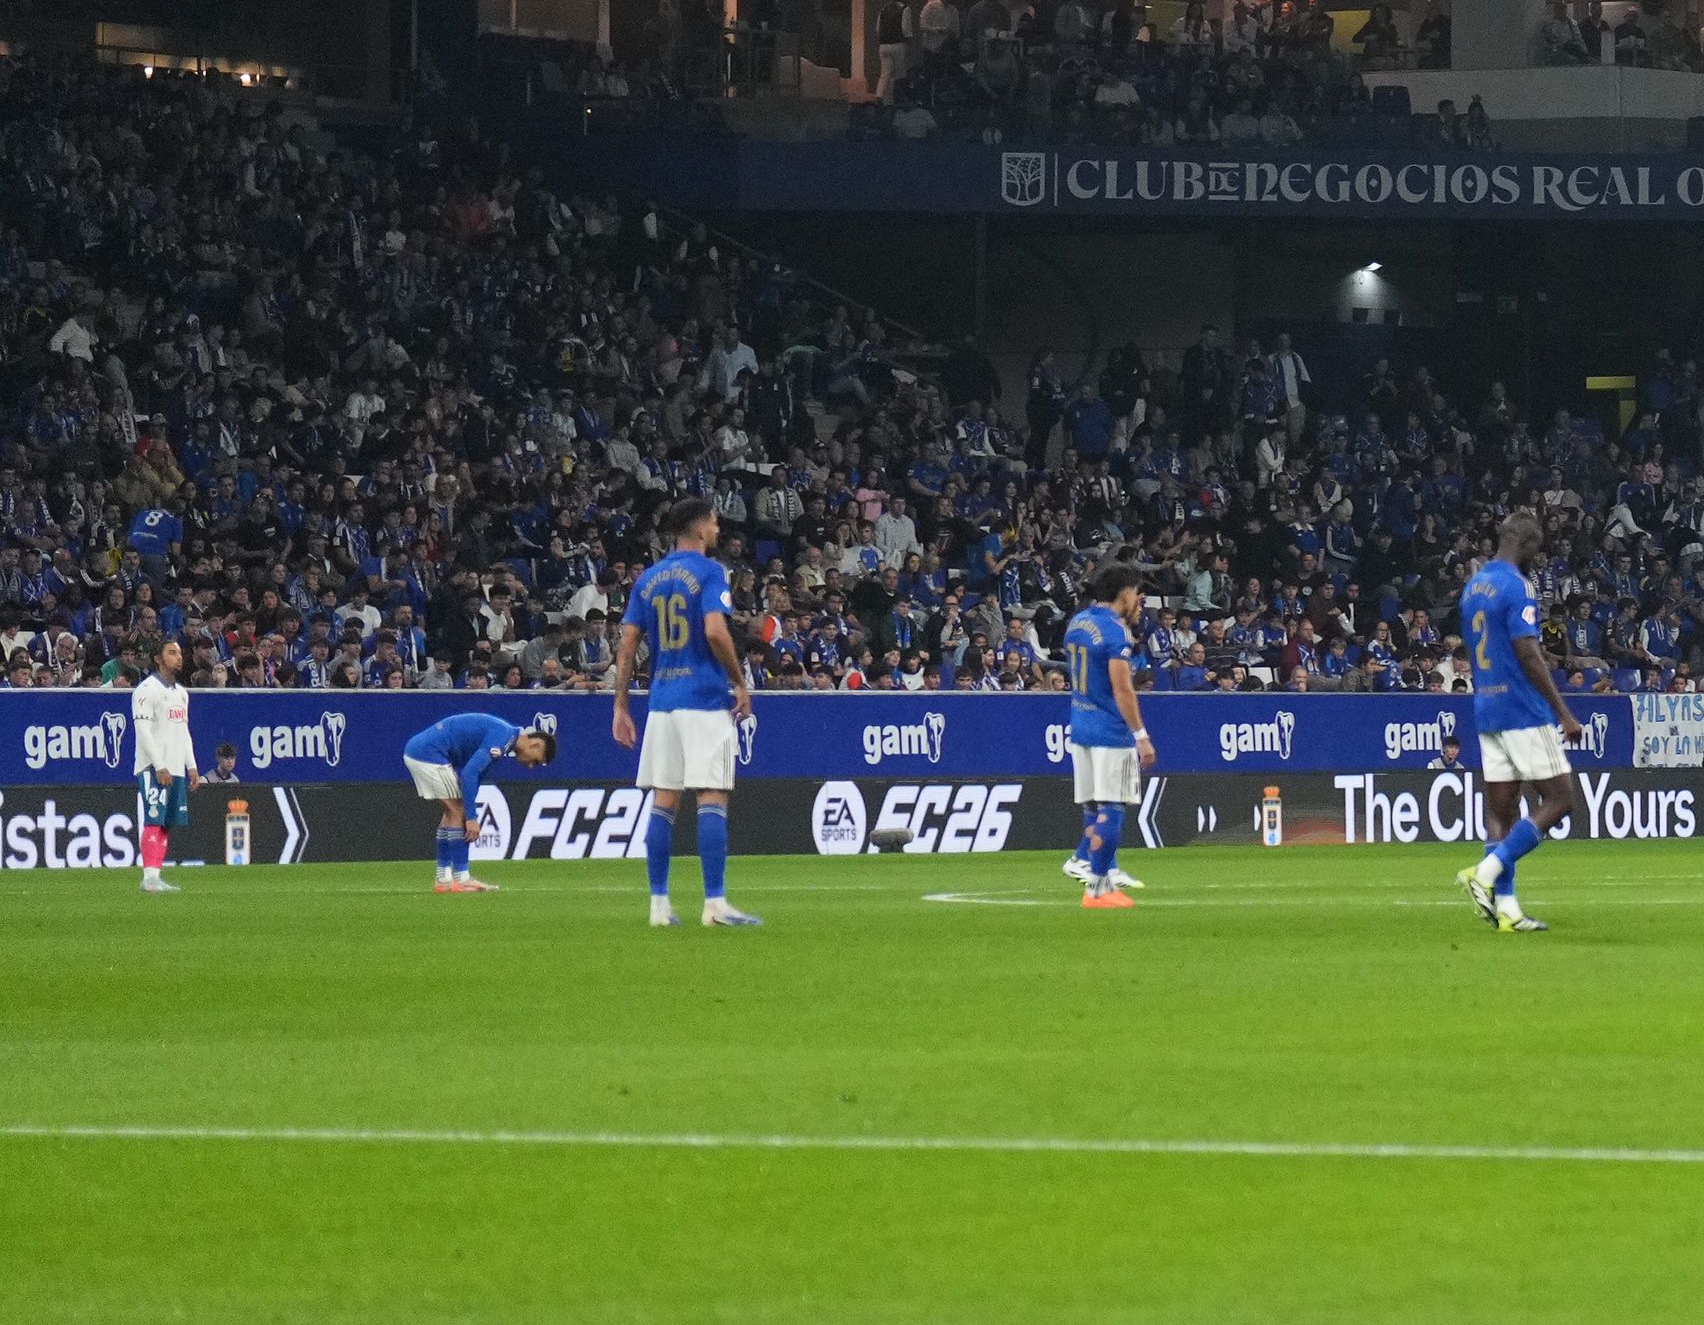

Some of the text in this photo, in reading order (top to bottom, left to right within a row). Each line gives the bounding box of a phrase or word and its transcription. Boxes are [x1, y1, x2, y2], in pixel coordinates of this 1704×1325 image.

[1066, 159, 1205, 201] CLUB
[1244, 162, 1520, 206] NEGOCIOS
[1531, 164, 1666, 211] REAL
[652, 593, 689, 652] 16
[1472, 610, 1492, 670] 2
[1067, 643, 1088, 696] 11
[24, 723, 104, 769] gam
[249, 723, 326, 769] gam
[863, 723, 928, 764] gam
[1220, 722, 1281, 760] gam
[1385, 721, 1444, 759] gam
[149, 787, 167, 806] 24
[1333, 774, 1420, 844] The
[1578, 772, 1696, 840] Yours
[820, 828, 858, 843] SPORTS
